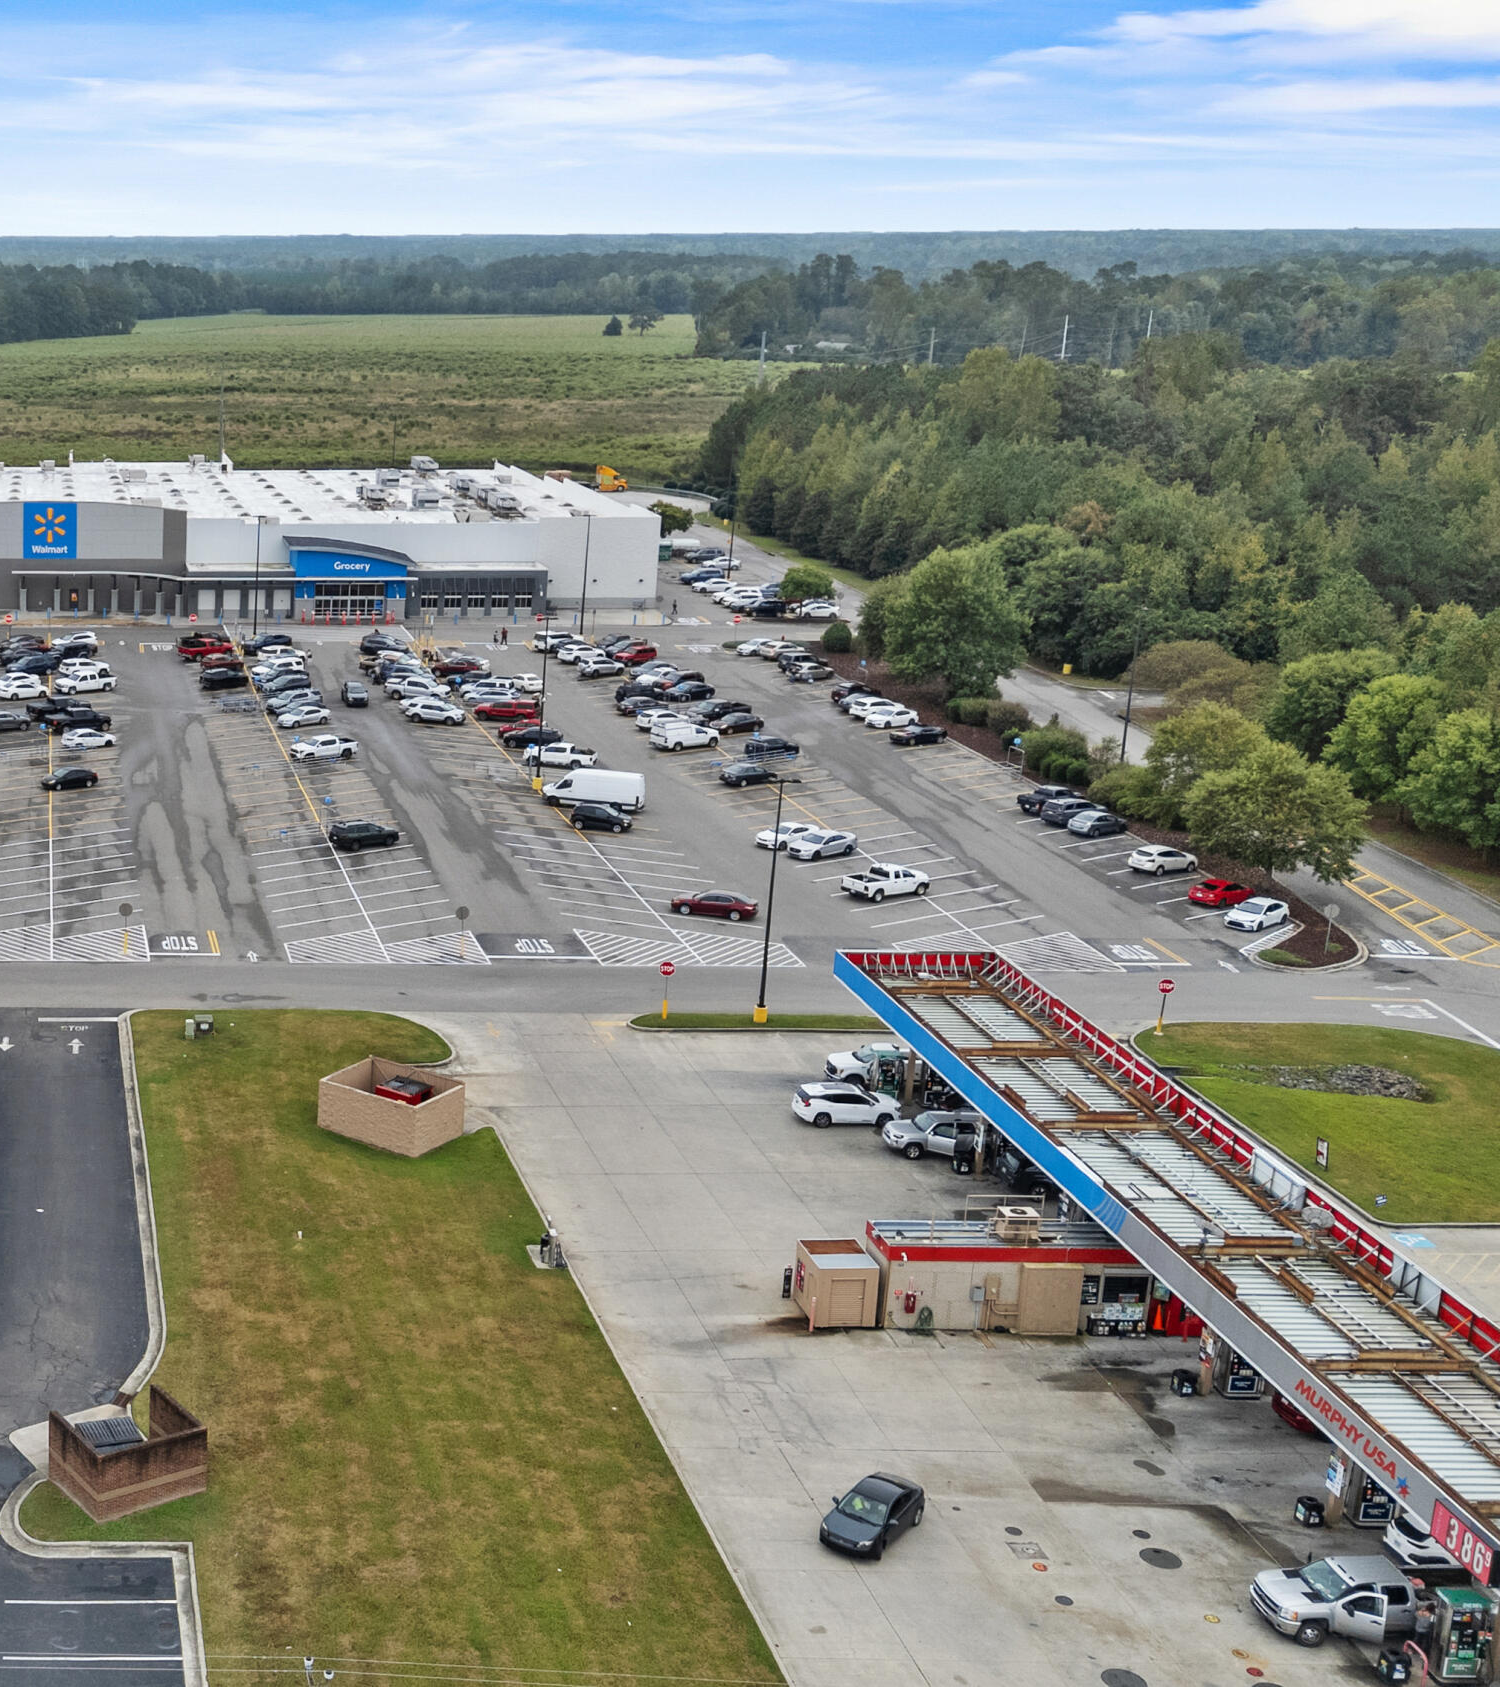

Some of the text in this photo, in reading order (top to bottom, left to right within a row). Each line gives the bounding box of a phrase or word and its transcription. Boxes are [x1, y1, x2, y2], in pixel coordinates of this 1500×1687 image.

[31, 545, 68, 554] Walmart
[334, 561, 370, 572] Grocery
[162, 936, 198, 950] STOP
[514, 938, 555, 953] STOP
[1294, 1379, 1364, 1444] MURPHY
[1363, 1440, 1398, 1480] USA
